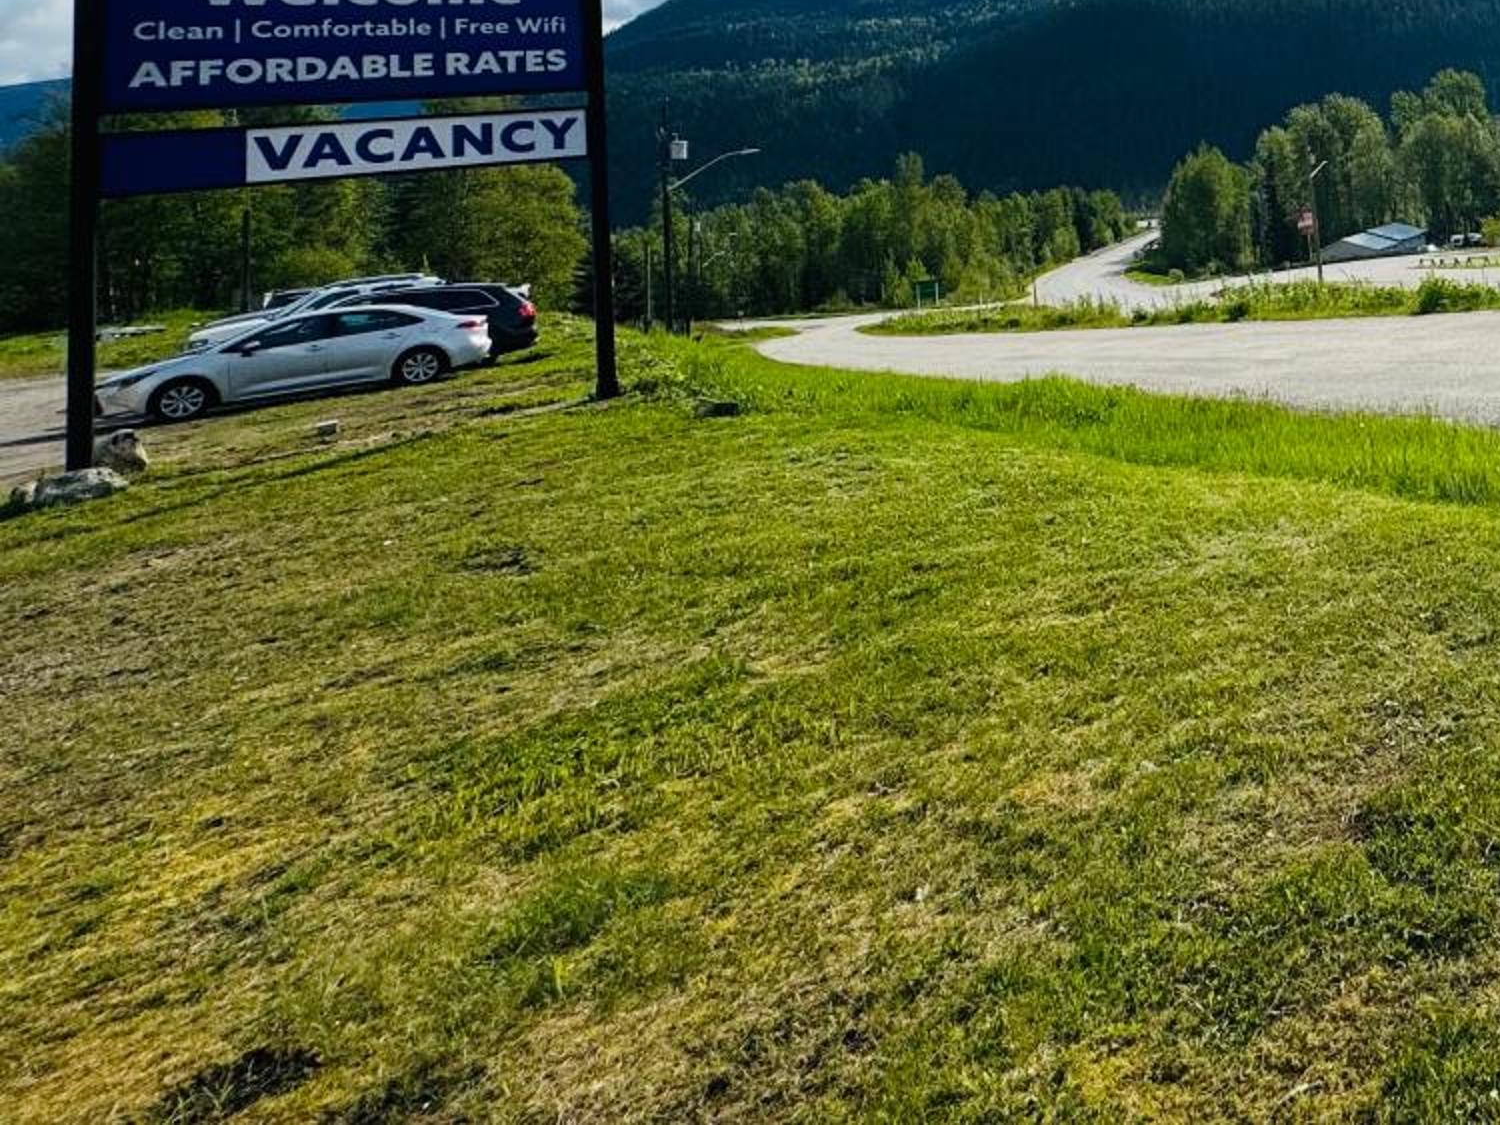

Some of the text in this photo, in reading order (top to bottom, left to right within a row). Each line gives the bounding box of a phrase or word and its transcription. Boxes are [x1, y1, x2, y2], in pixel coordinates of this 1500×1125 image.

[133, 16, 566, 42] Clean Comfortable Free Wifi
[128, 48, 567, 88] AFFORDABLE RATES
[253, 117, 578, 172] VACANCY
